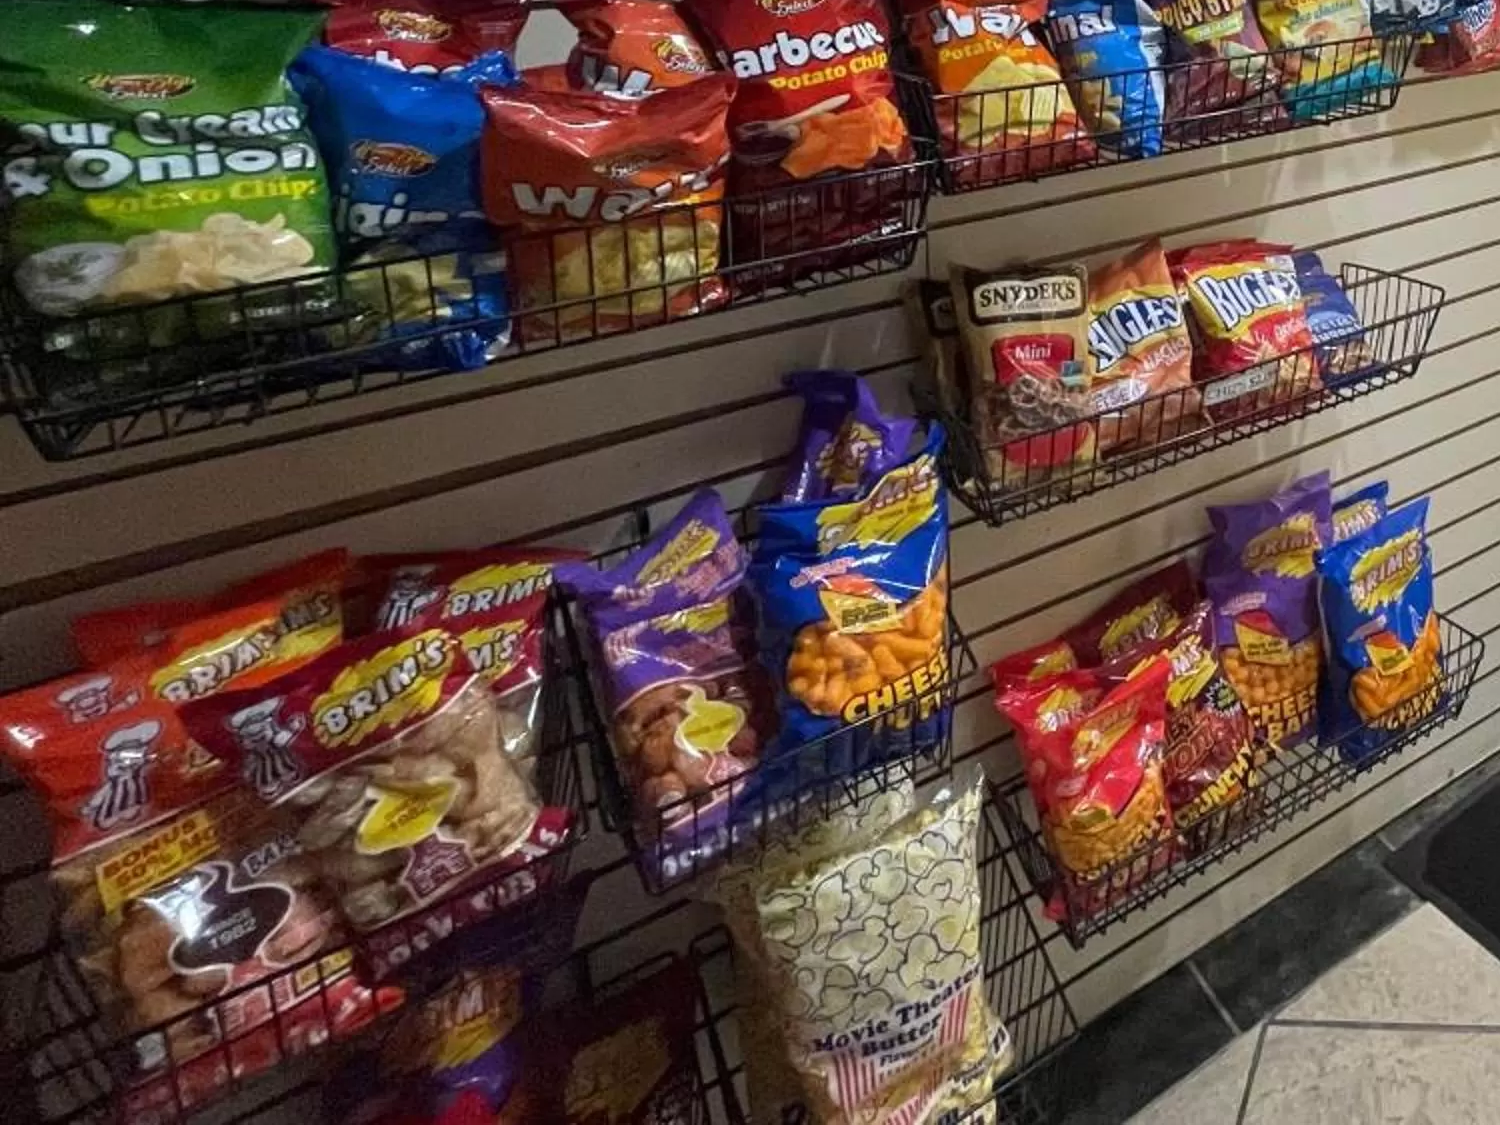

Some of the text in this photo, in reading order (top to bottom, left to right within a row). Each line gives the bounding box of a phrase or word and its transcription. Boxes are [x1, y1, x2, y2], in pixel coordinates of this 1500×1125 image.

[730, 21, 886, 78] arbecue
[768, 62, 847, 90] Potato
[18, 105, 303, 148] our Cream
[63, 141, 319, 190] Onion
[978, 280, 1077, 309] SNYDER'S
[1014, 341, 1052, 360] Mini
[319, 635, 447, 737] BRIM'S
[104, 818, 198, 881] BONUS
[810, 963, 983, 1055] Movie Theater
[859, 1014, 943, 1059] Butter
